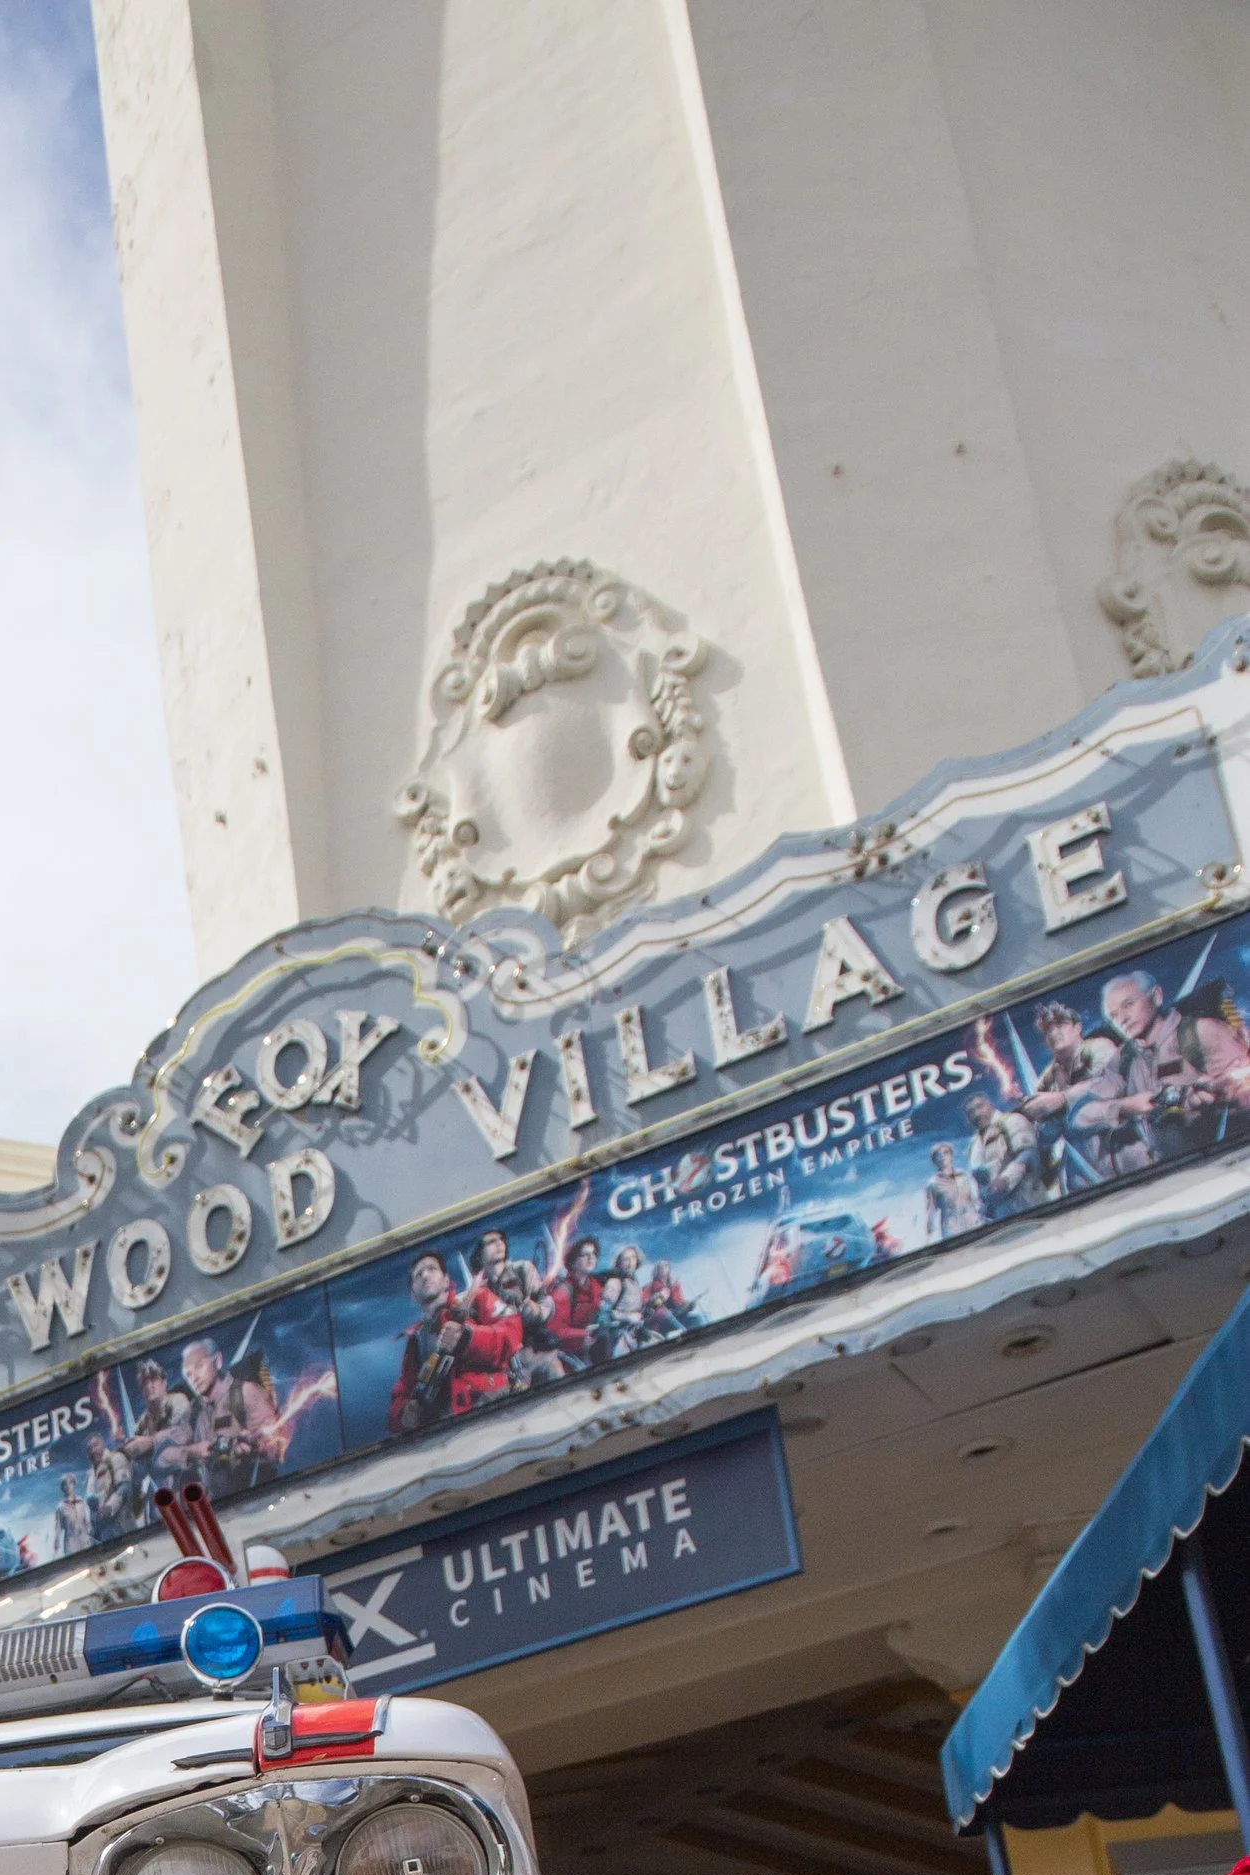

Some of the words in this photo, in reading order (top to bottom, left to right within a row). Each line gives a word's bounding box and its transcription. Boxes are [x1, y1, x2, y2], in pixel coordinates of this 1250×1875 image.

[452, 801, 1129, 1161] VILLAGE
[189, 1008, 400, 1159] FOX
[670, 1170, 786, 1227] FROZEN
[801, 1117, 916, 1175] EMPIRE
[442, 1477, 692, 1593] ULTIMATE
[450, 1527, 698, 1628] CINEMA
